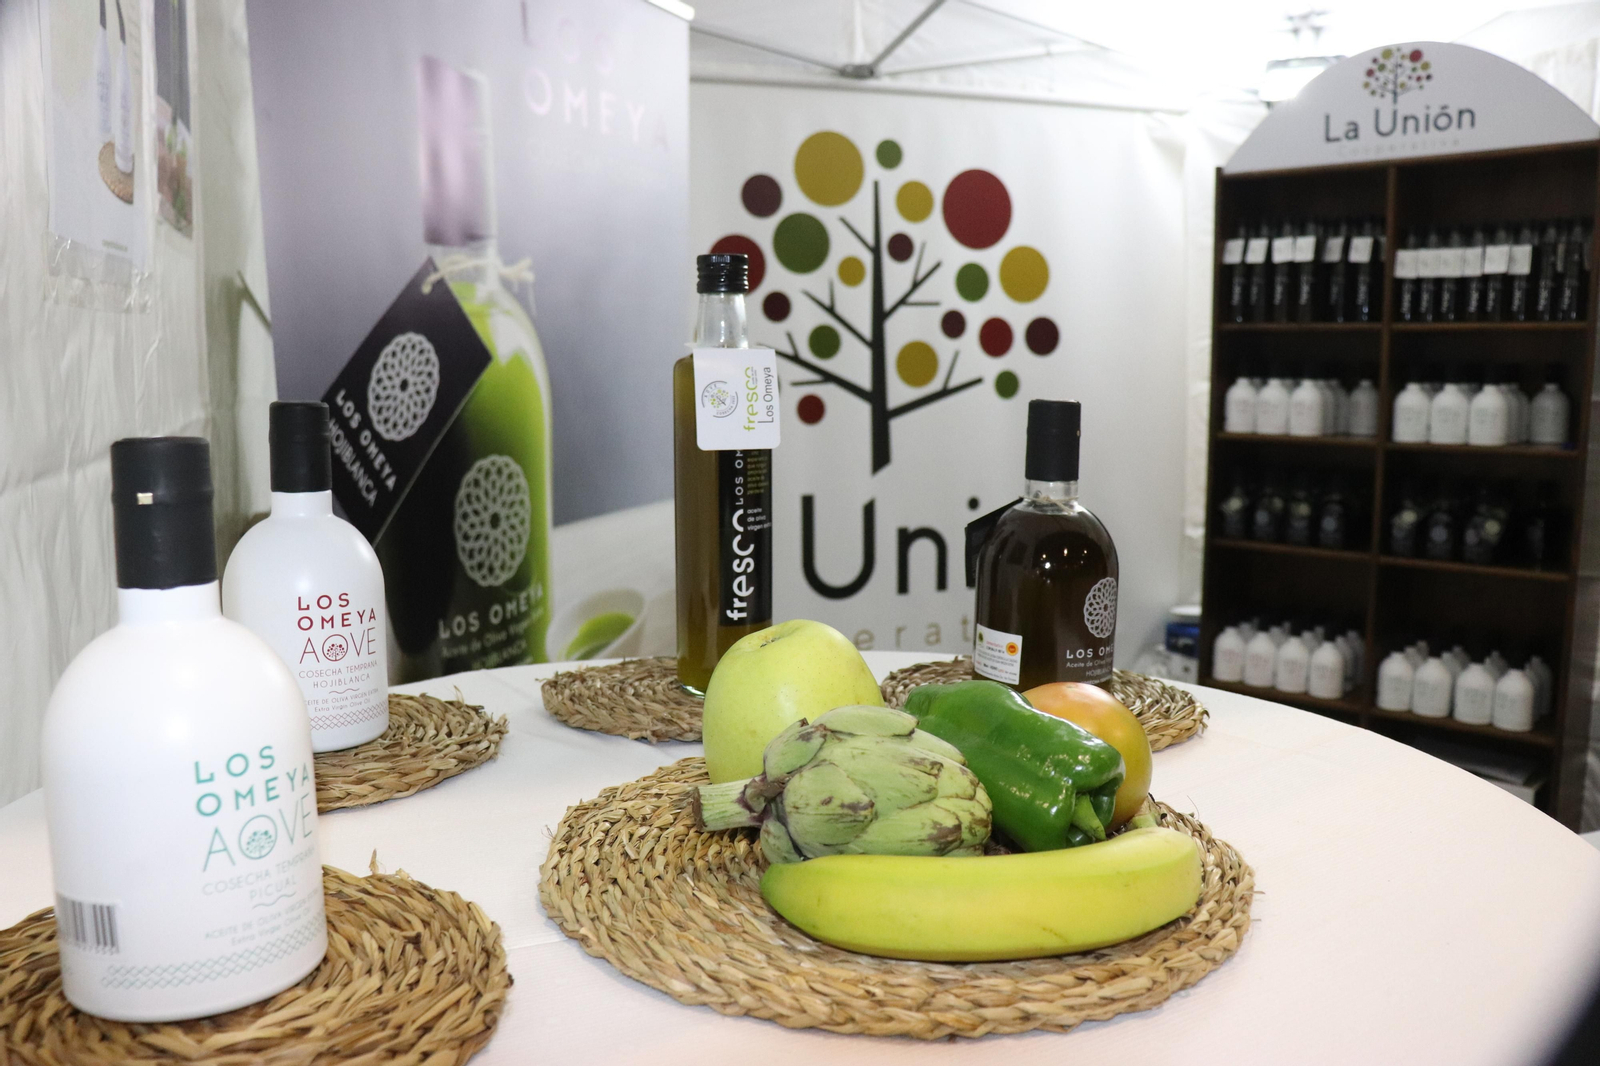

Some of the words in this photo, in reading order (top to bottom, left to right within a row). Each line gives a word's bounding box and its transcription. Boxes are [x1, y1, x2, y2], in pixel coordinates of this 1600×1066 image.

[1325, 114, 1359, 143] La
[1374, 104, 1476, 138] Unión
[763, 367, 774, 402] Omeya
[757, 404, 774, 423] Los
[336, 388, 361, 429] LOS
[360, 429, 396, 492] OMEYA
[735, 476, 744, 505] LOS
[801, 495, 979, 600] Un
[297, 592, 350, 611] LOS
[297, 607, 377, 631] OMEYA
[438, 610, 480, 639] LOS
[299, 627, 377, 665] AOVE
[1066, 648, 1093, 659] LOS
[298, 668, 343, 679] COSECHA
[346, 660, 378, 674] TEMPRANA
[313, 673, 371, 689] HOJIBLANCA
[331, 696, 349, 704] OLIVA
[350, 692, 368, 701] VIRGEN
[195, 745, 275, 784] LOS
[196, 763, 310, 817] OMEYA
[203, 793, 313, 872] AOVE
[202, 869, 271, 896] COSECHA
[249, 875, 297, 901] PICUAL
